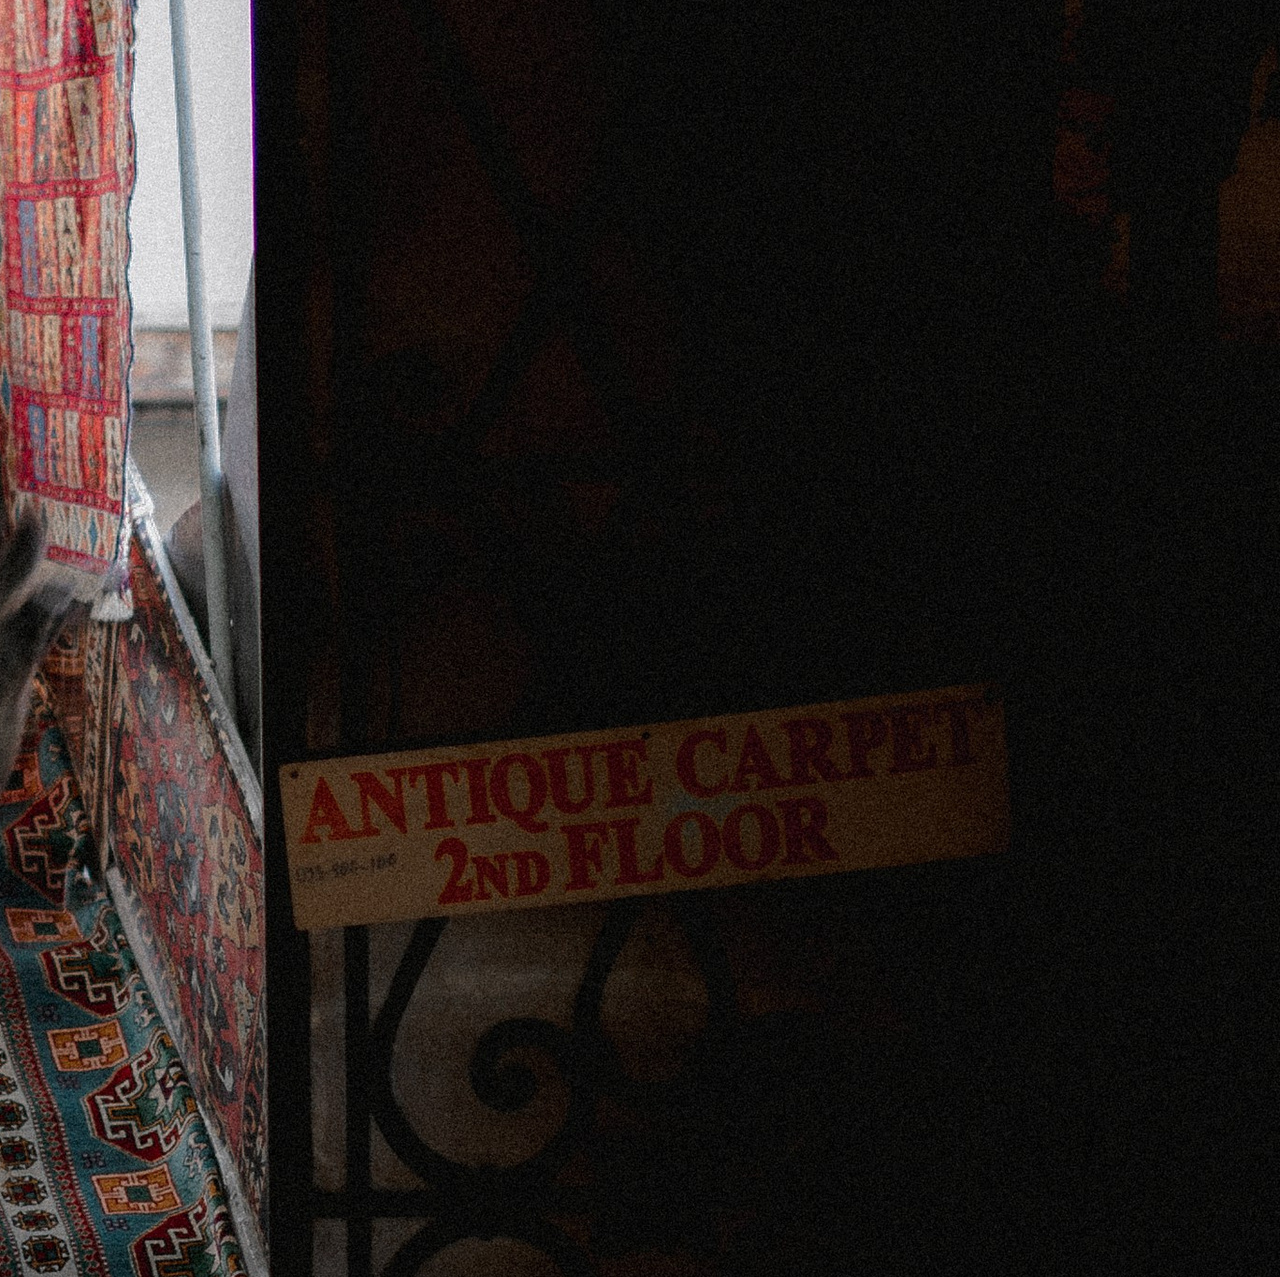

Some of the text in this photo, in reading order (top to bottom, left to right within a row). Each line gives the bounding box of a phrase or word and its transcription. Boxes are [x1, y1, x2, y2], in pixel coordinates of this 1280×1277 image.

[300, 697, 989, 845] ANTIQUE CARPET
[433, 836, 552, 906] 2ND
[561, 797, 840, 892] FLOOR
